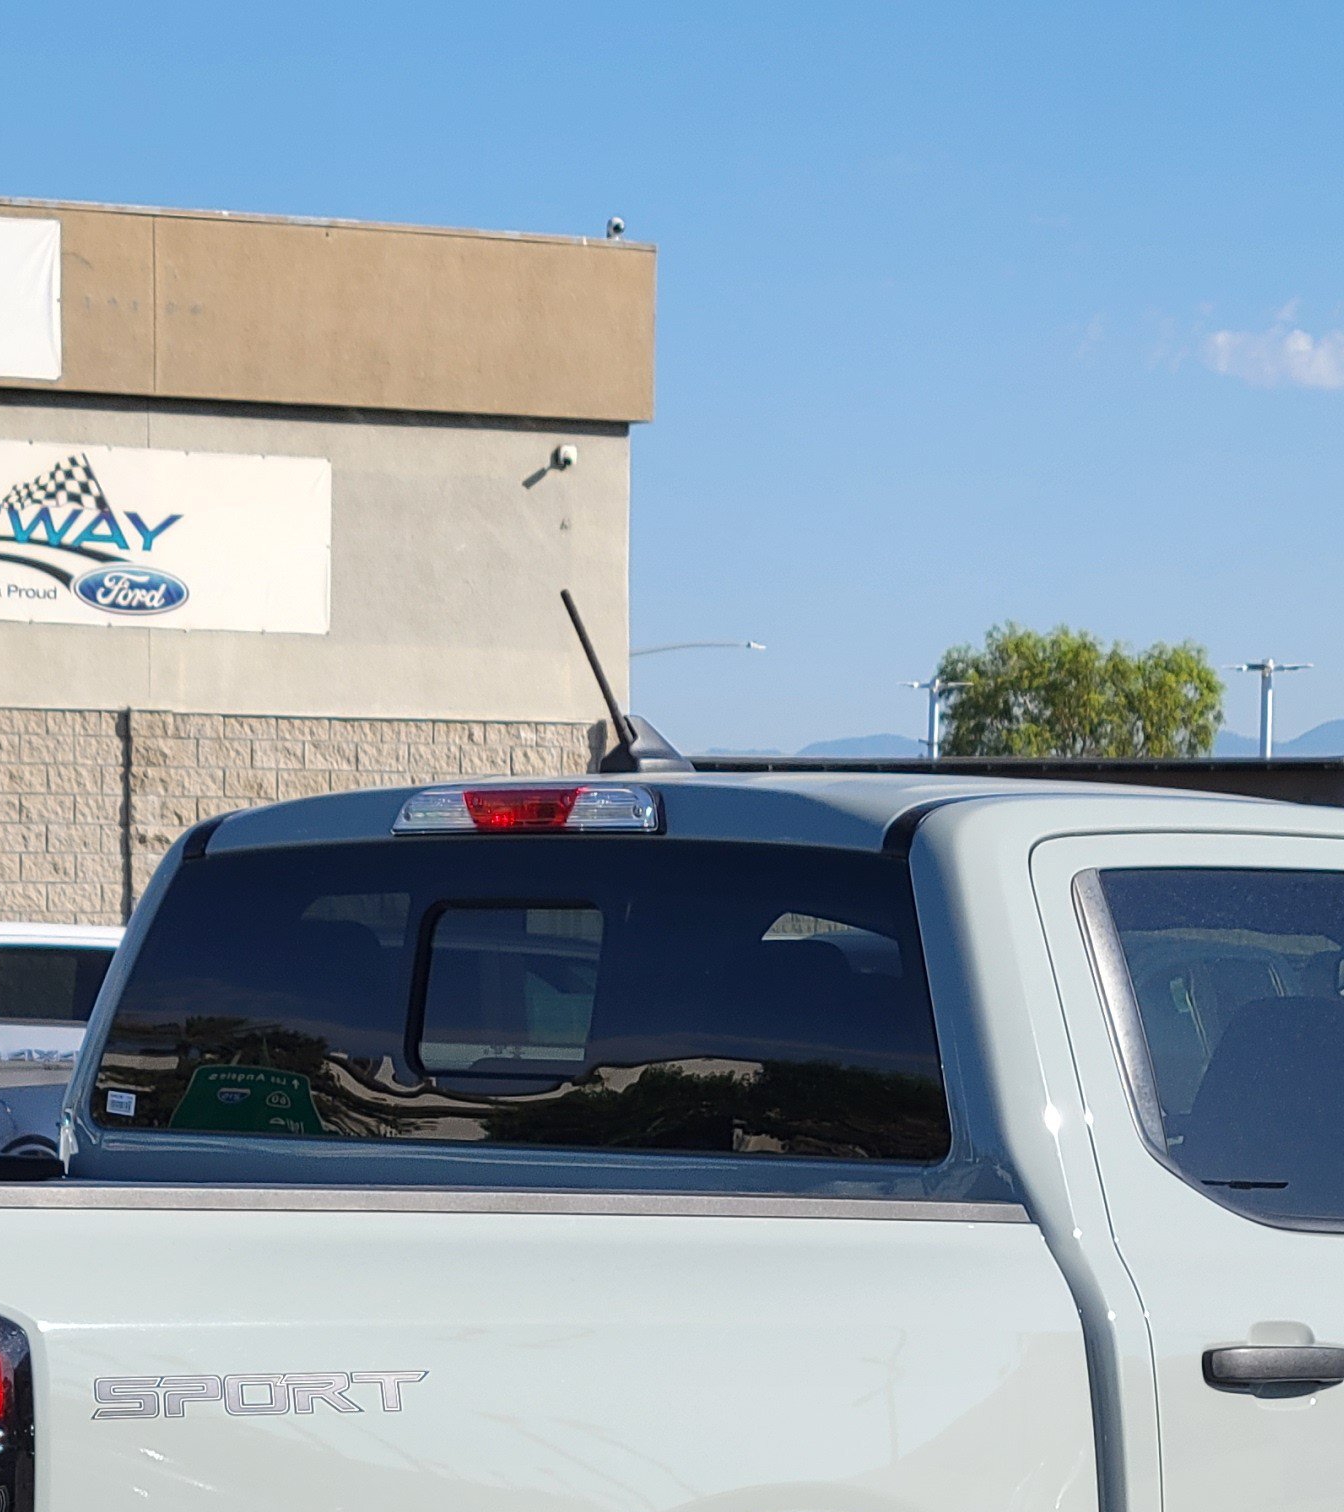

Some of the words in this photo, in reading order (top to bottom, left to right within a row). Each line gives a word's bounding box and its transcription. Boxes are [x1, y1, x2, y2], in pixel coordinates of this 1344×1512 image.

[6, 581, 57, 600] Proud
[94, 571, 167, 610] Ford
[91, 1370, 430, 1420] SPORT
